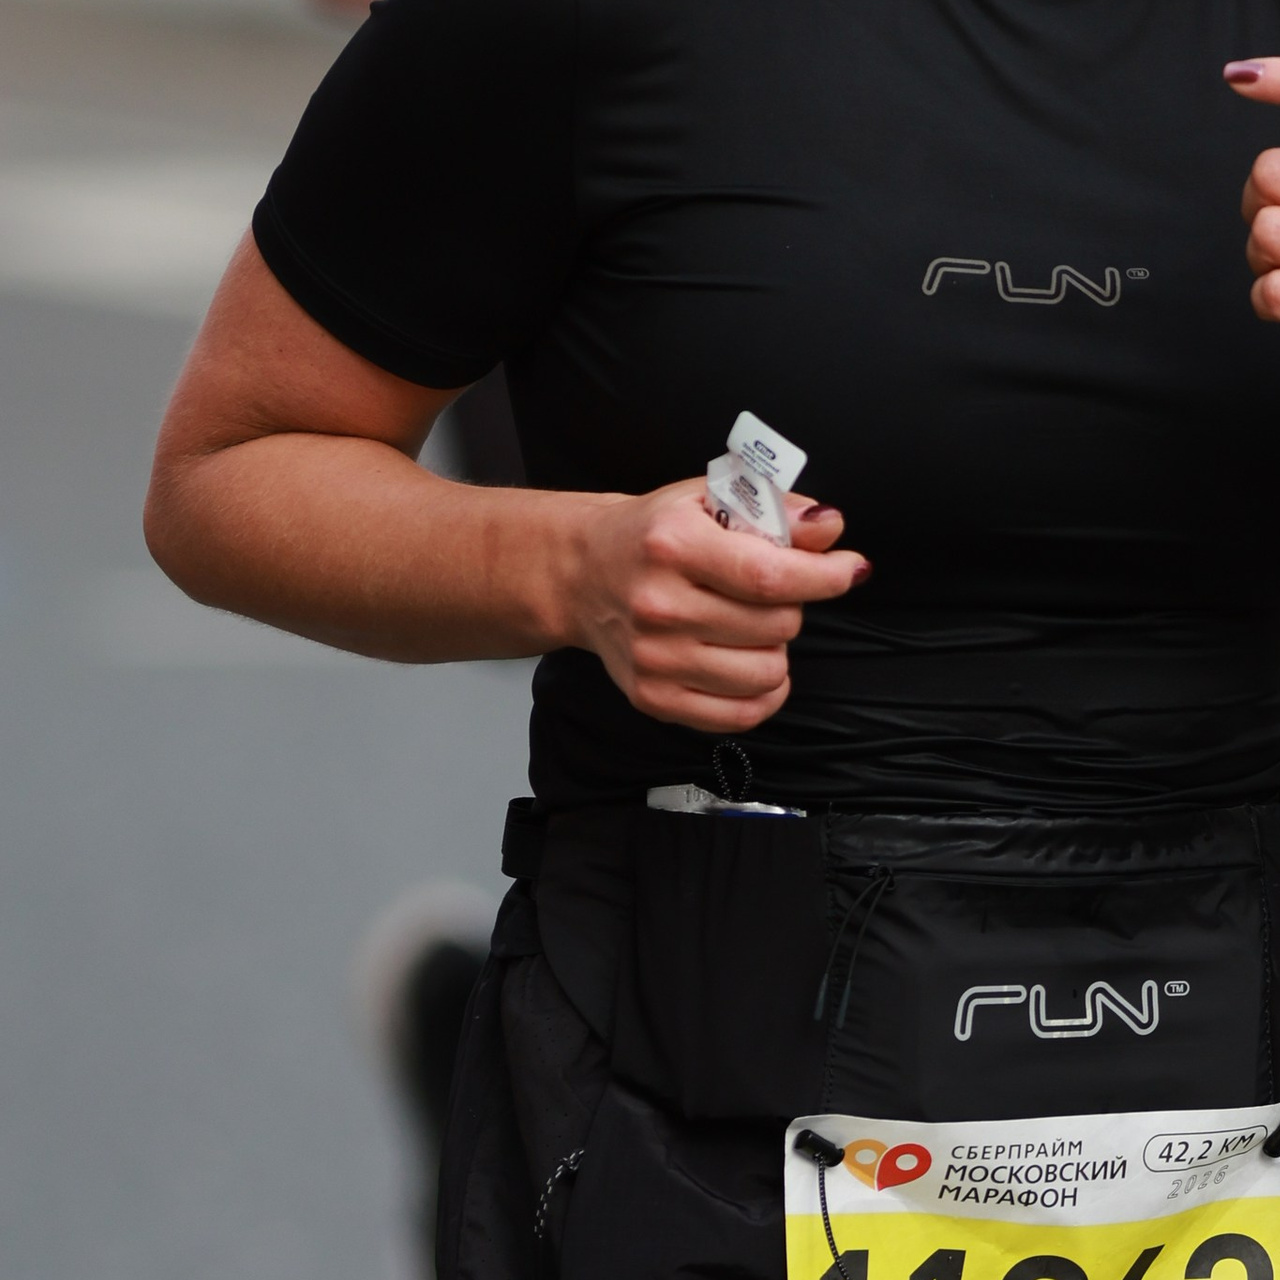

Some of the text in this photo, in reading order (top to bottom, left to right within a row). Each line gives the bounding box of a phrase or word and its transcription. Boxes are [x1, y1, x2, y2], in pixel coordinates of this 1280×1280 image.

[951, 1138, 1083, 1160] СБЕРПРАЙМ
[1158, 1140, 1213, 1167] 42,2
[944, 1155, 1127, 1184] МОСКОВСКИЙ
[1167, 1165, 1229, 1199] 2026
[938, 1184, 1078, 1208] МАРАФОН
